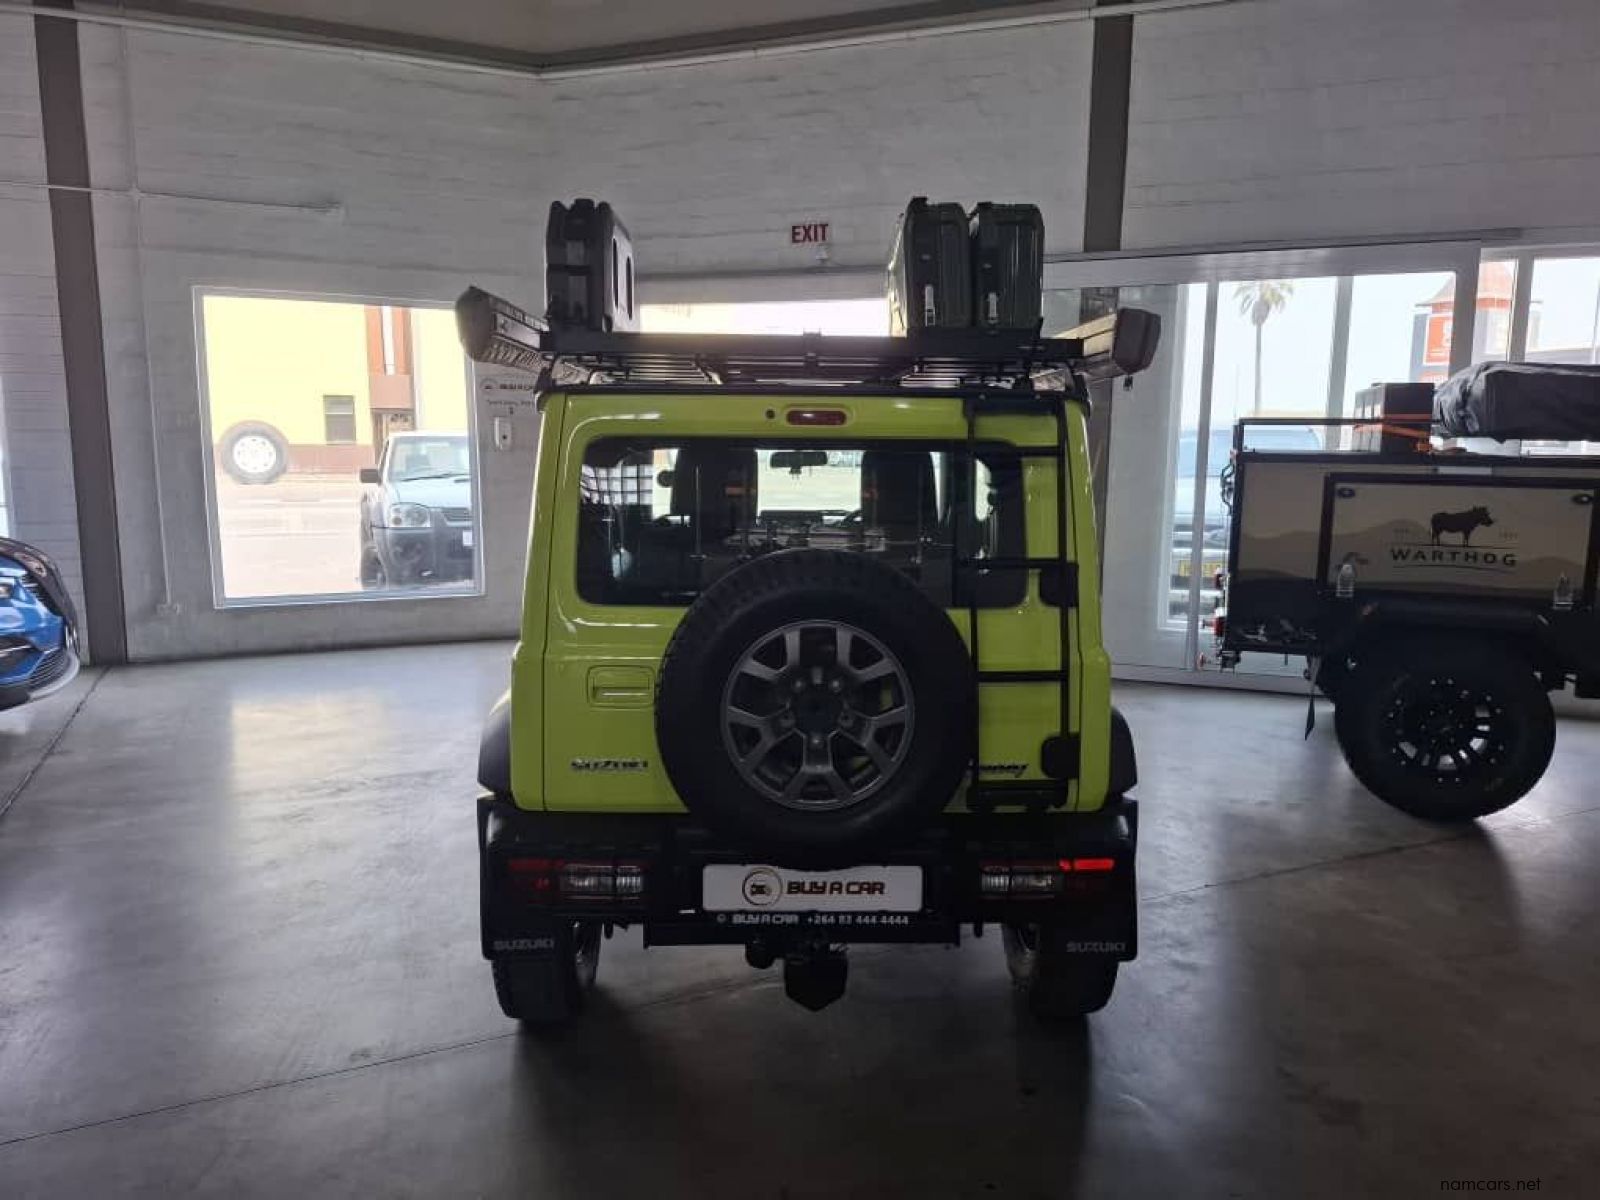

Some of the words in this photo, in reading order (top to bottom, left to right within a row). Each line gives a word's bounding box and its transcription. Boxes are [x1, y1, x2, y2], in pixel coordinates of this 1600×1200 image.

[791, 223, 829, 243] EXIT
[1389, 547, 1518, 567] WARTHOG
[570, 756, 649, 771] SUZUKI
[786, 881, 828, 895] BUY
[829, 881, 843, 895] A
[845, 881, 885, 895] CAR
[731, 913, 760, 925] BUY
[761, 913, 771, 925] A
[772, 913, 800, 925] CAR
[493, 938, 555, 951] SUZUKI
[1065, 941, 1127, 953] SUZUKI
